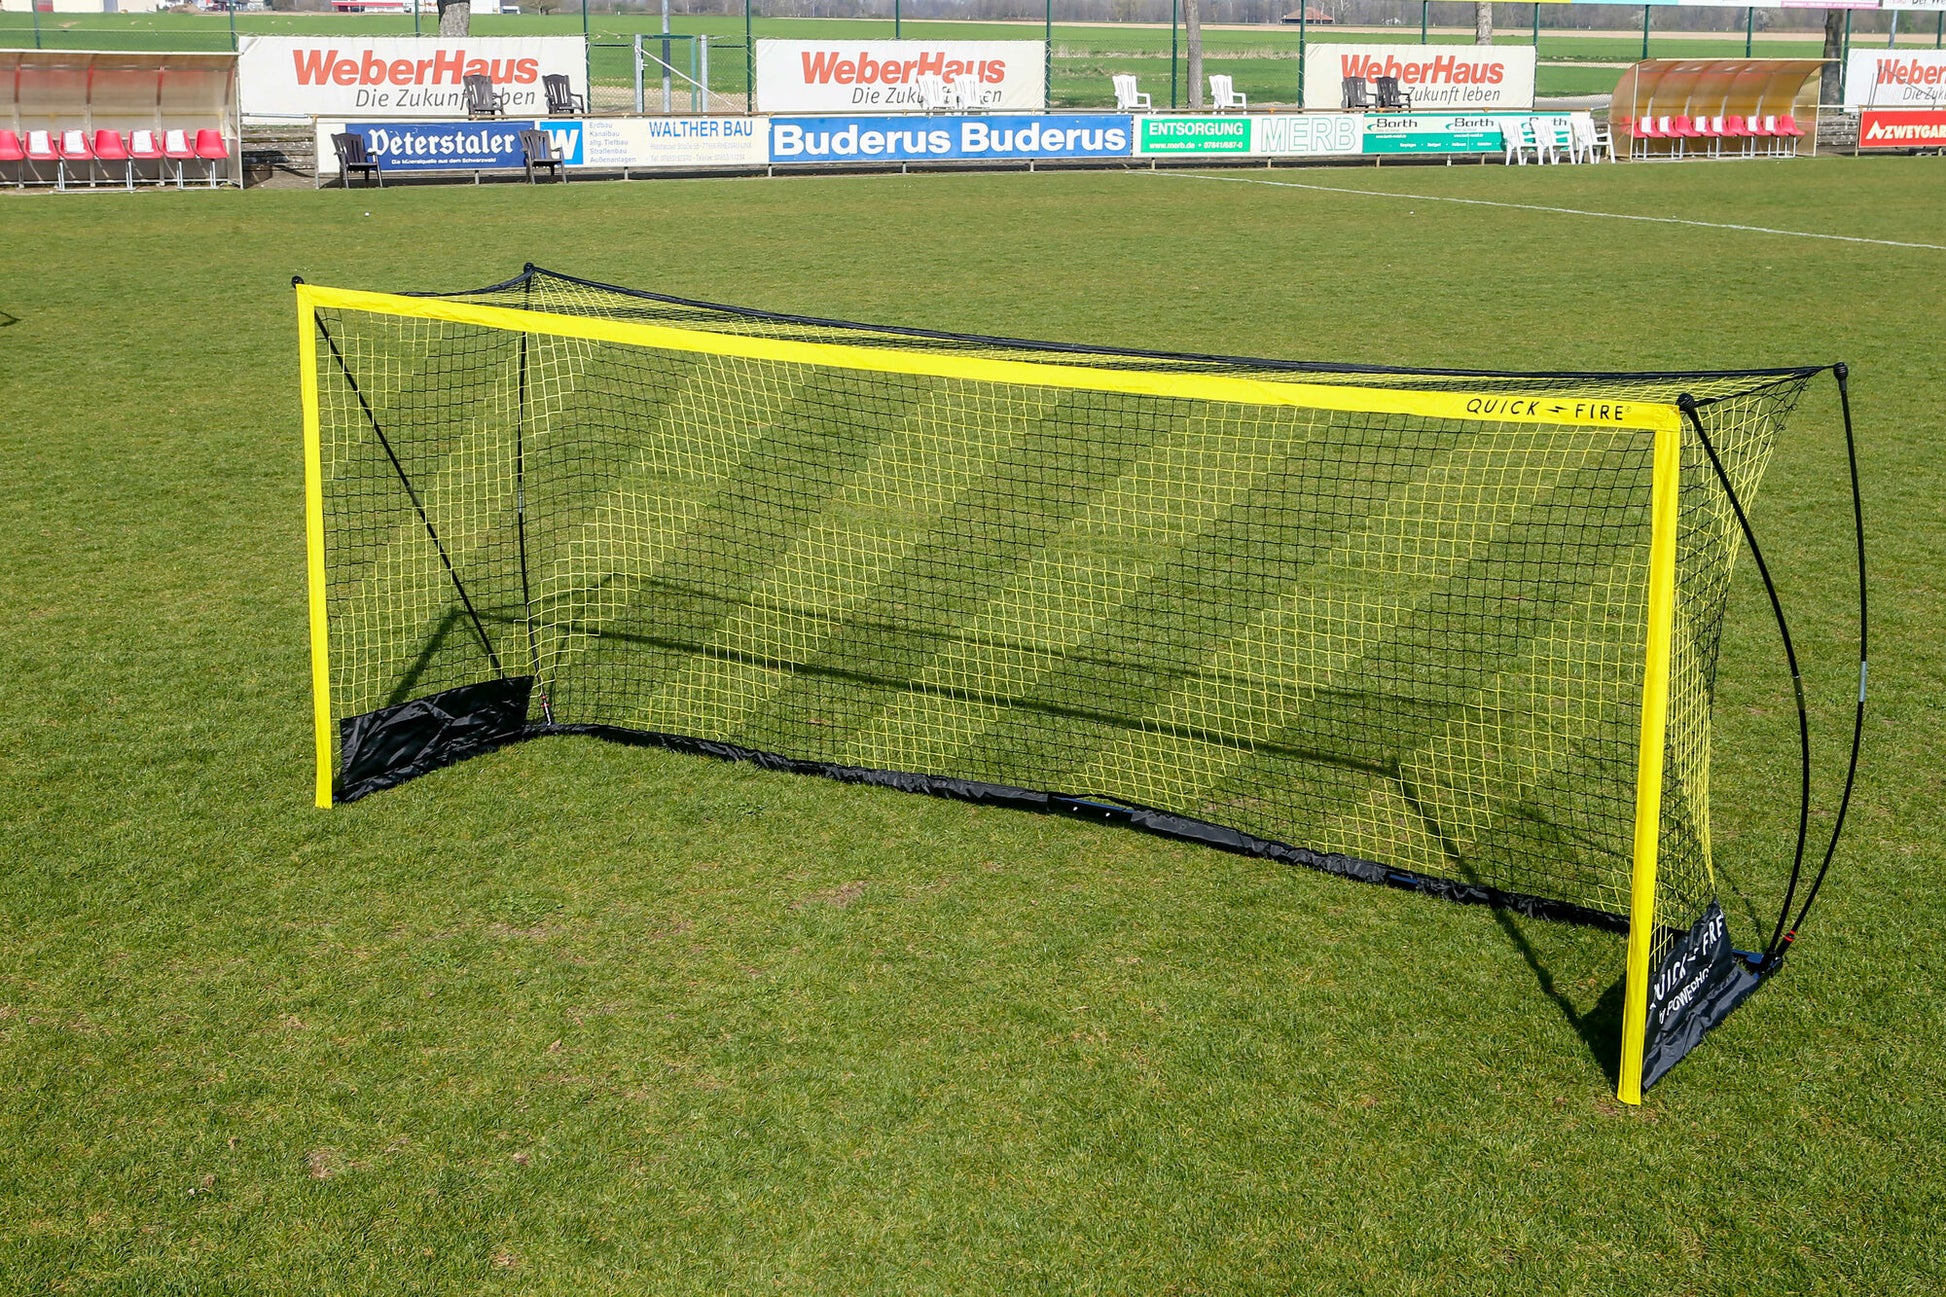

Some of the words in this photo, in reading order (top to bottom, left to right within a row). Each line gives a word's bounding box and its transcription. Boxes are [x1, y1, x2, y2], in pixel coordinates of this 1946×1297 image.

[292, 49, 539, 86] WeberHaus
[801, 51, 1006, 84] WeberHaus
[1341, 54, 1504, 84] WeberHaus
[355, 89, 389, 107] Die
[396, 88, 468, 110] Zukunf
[852, 87, 880, 104] Die
[1405, 86, 1460, 105] Zukunft
[1462, 86, 1501, 102] leben
[1903, 86, 1923, 100] Die
[649, 121, 719, 138] WALTHER
[723, 120, 753, 137] BAU
[1149, 122, 1244, 136] ENTSORGUNG
[1377, 118, 1418, 128] Barth
[1454, 117, 1494, 127] Barth
[368, 128, 516, 156] Peterstaler
[605, 138, 628, 146] Tiefbau
[773, 122, 951, 156] Buderus
[961, 121, 1126, 153] Buderus
[1260, 117, 1356, 152] MERB
[1149, 141, 1195, 149] www.merb.de
[1466, 398, 1540, 416] QUICK
[1649, 952, 1688, 1010] UICK
